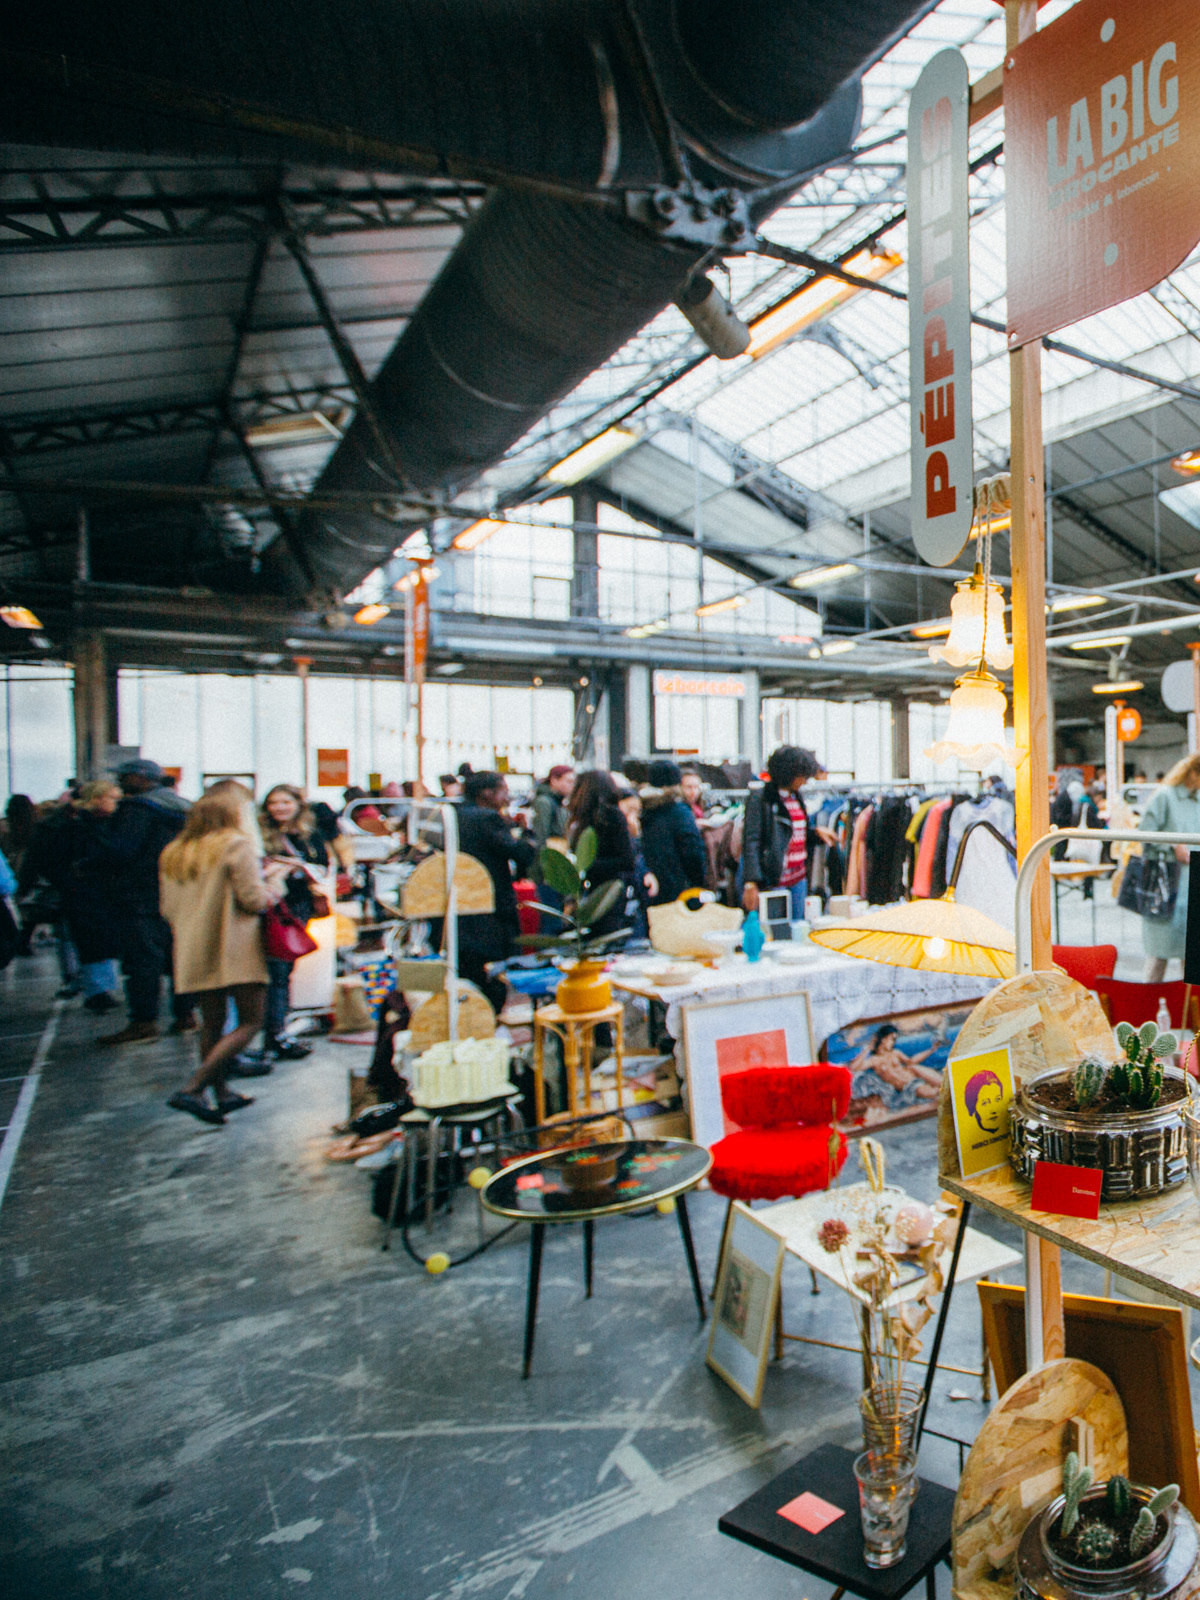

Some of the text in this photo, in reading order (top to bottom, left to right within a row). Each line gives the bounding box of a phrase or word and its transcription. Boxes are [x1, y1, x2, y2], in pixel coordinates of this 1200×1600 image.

[1047, 41, 1179, 186] LA BIG
[1047, 121, 1179, 211] BROCANTE
[920, 95, 956, 520] PÉPITES
